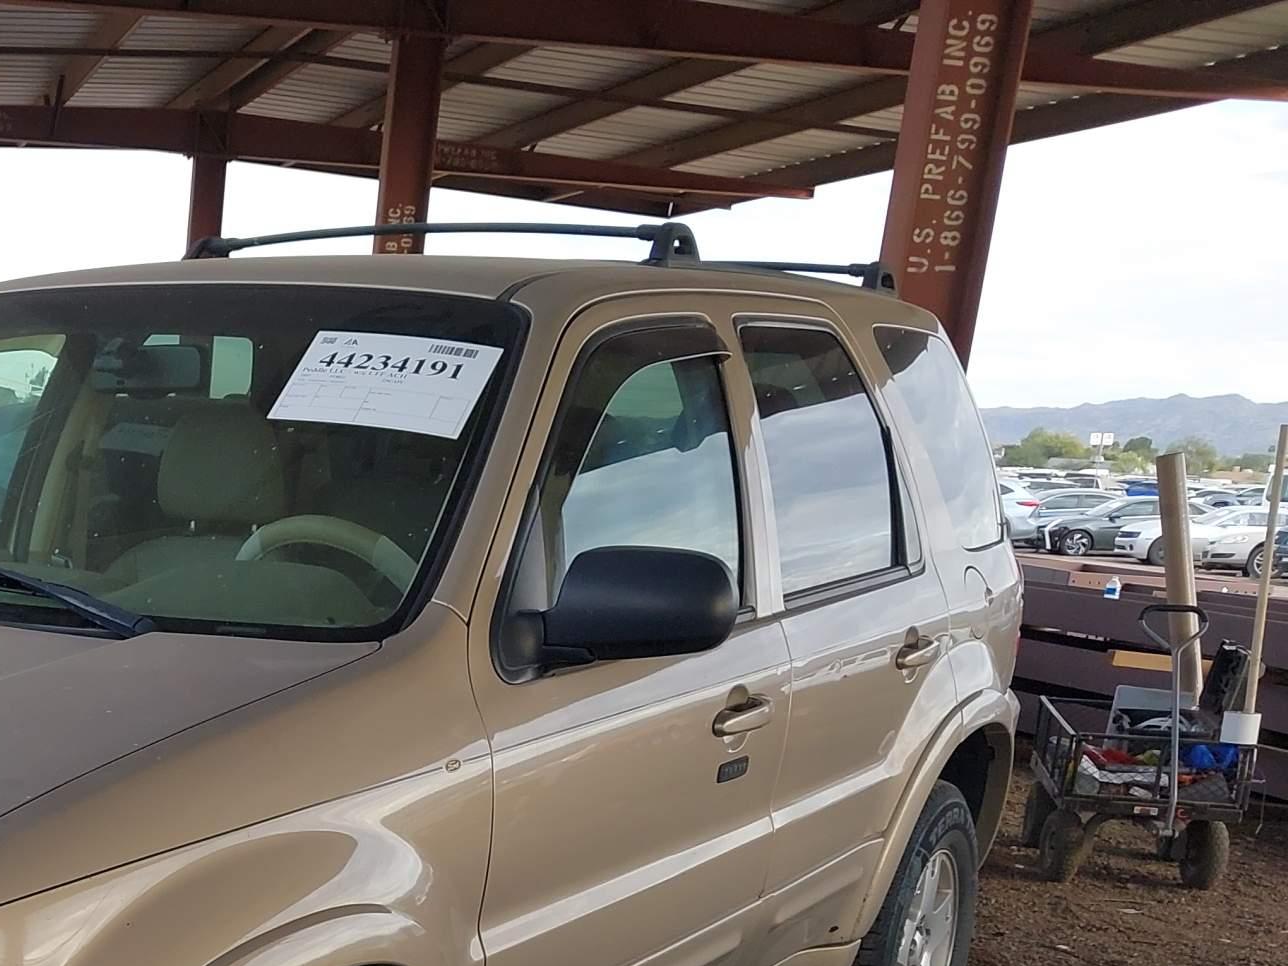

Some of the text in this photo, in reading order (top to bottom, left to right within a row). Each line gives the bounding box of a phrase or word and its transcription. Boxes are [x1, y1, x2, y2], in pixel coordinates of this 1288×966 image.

[907, 10, 973, 273] U.S. PREFAB INC.
[934, 14, 998, 271] 1-866-799-0969
[319, 351, 464, 380] 44234191
